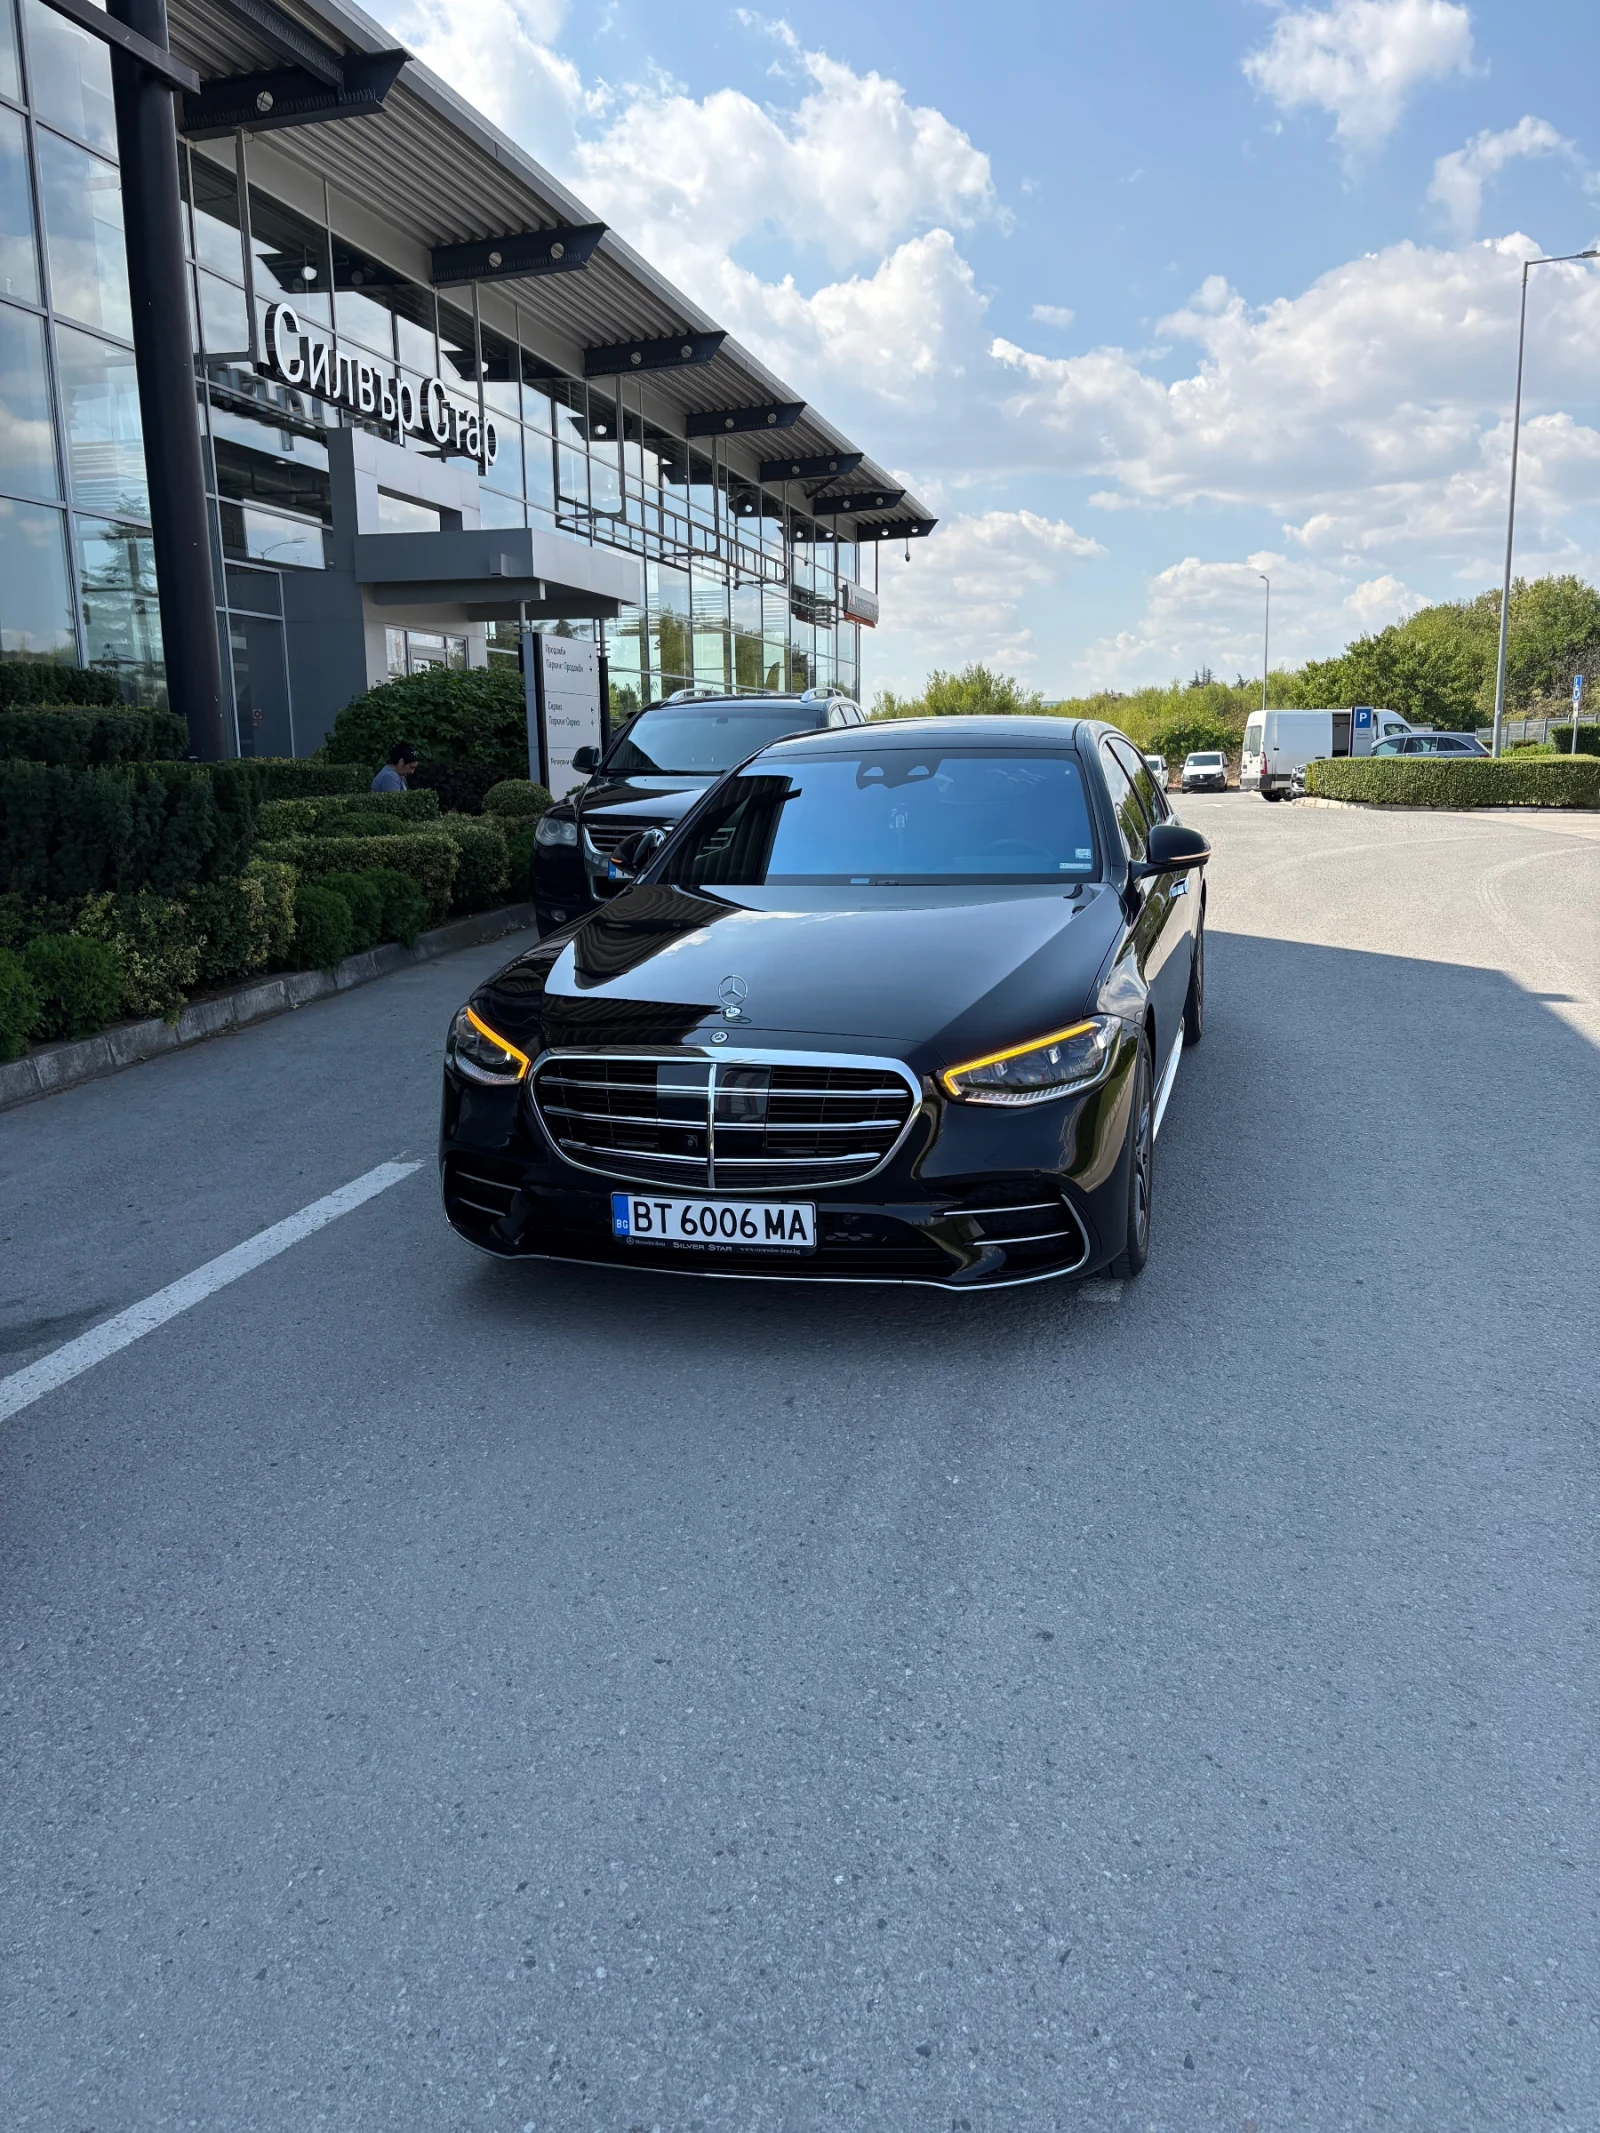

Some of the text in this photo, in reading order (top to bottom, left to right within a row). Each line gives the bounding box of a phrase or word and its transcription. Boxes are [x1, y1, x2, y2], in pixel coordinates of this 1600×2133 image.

[267, 302, 499, 476] Силвър Стар
[1359, 712, 1368, 722] P
[616, 1219, 629, 1229] BG
[633, 1201, 808, 1241] BT 6006 MA
